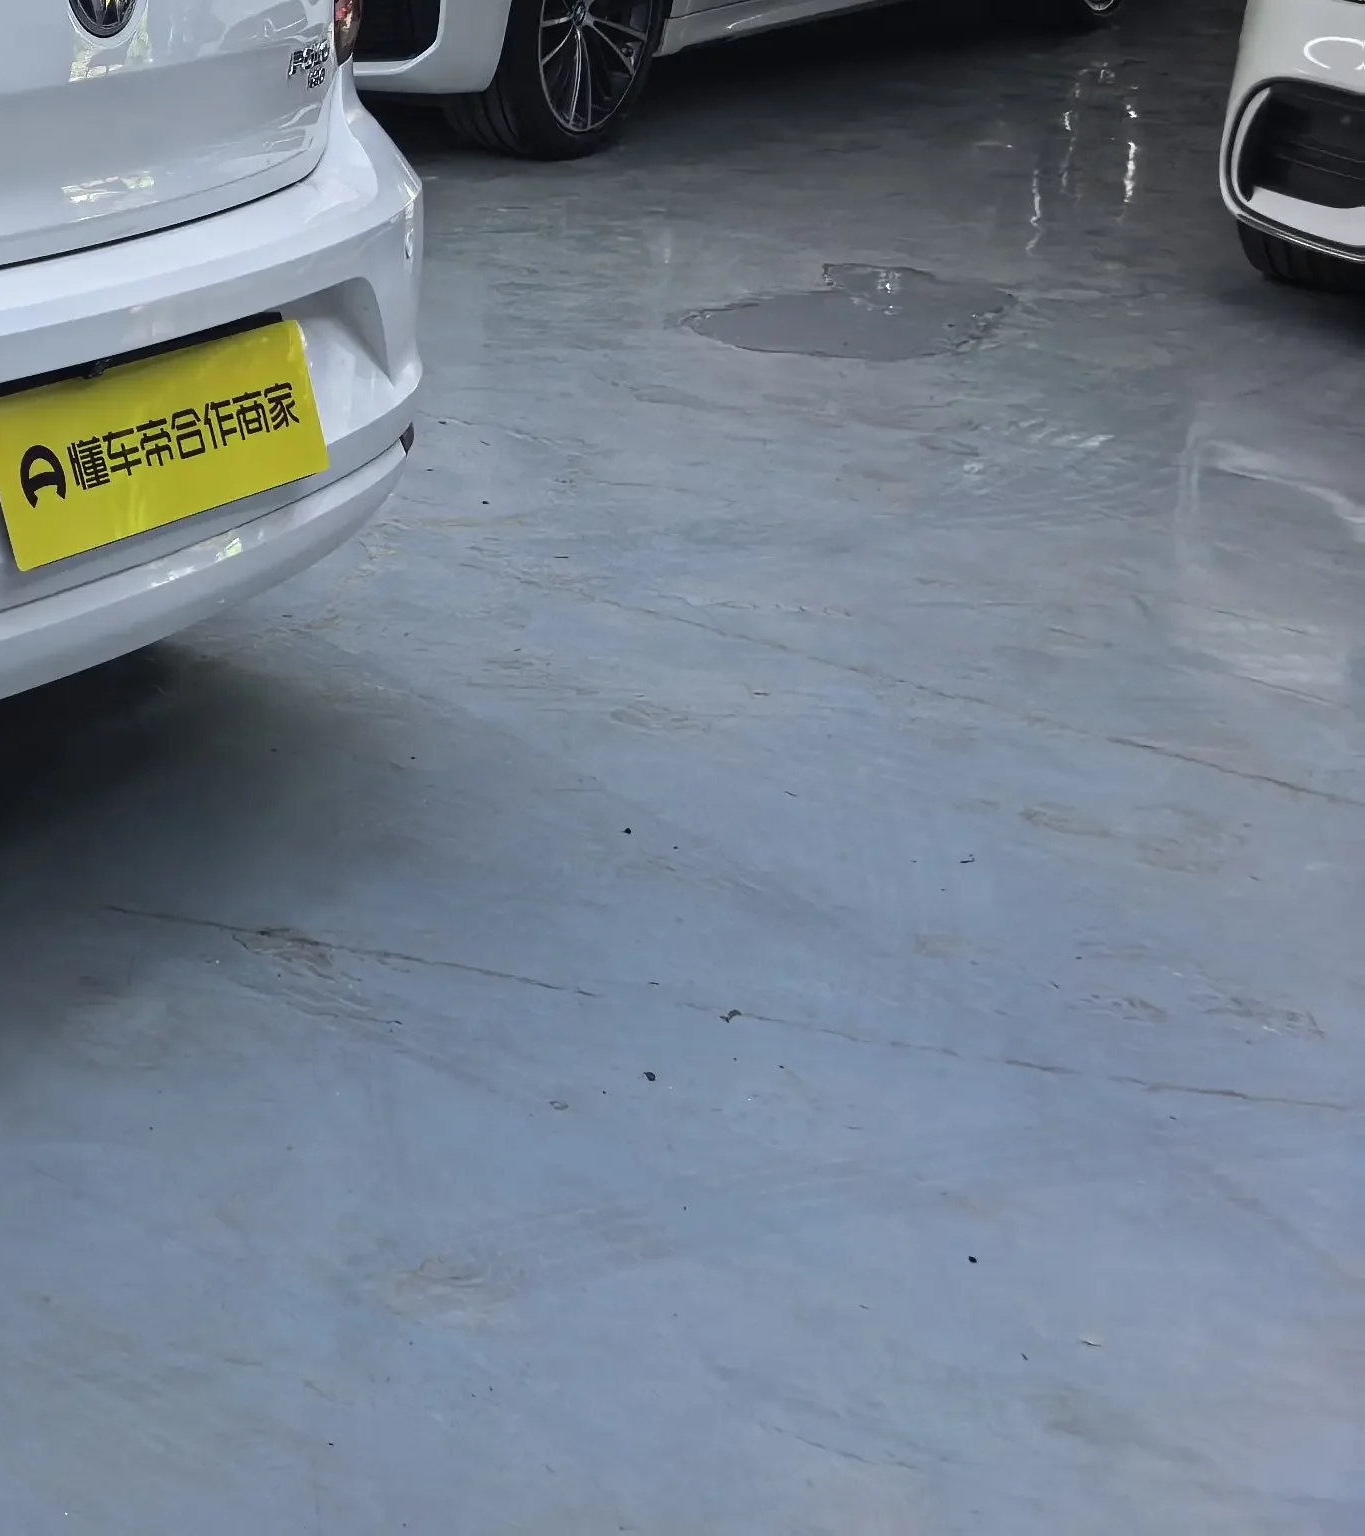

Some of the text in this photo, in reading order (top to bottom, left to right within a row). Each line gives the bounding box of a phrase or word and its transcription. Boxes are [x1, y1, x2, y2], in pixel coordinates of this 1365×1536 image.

[67, 382, 300, 490] 懂车帝合作商家
